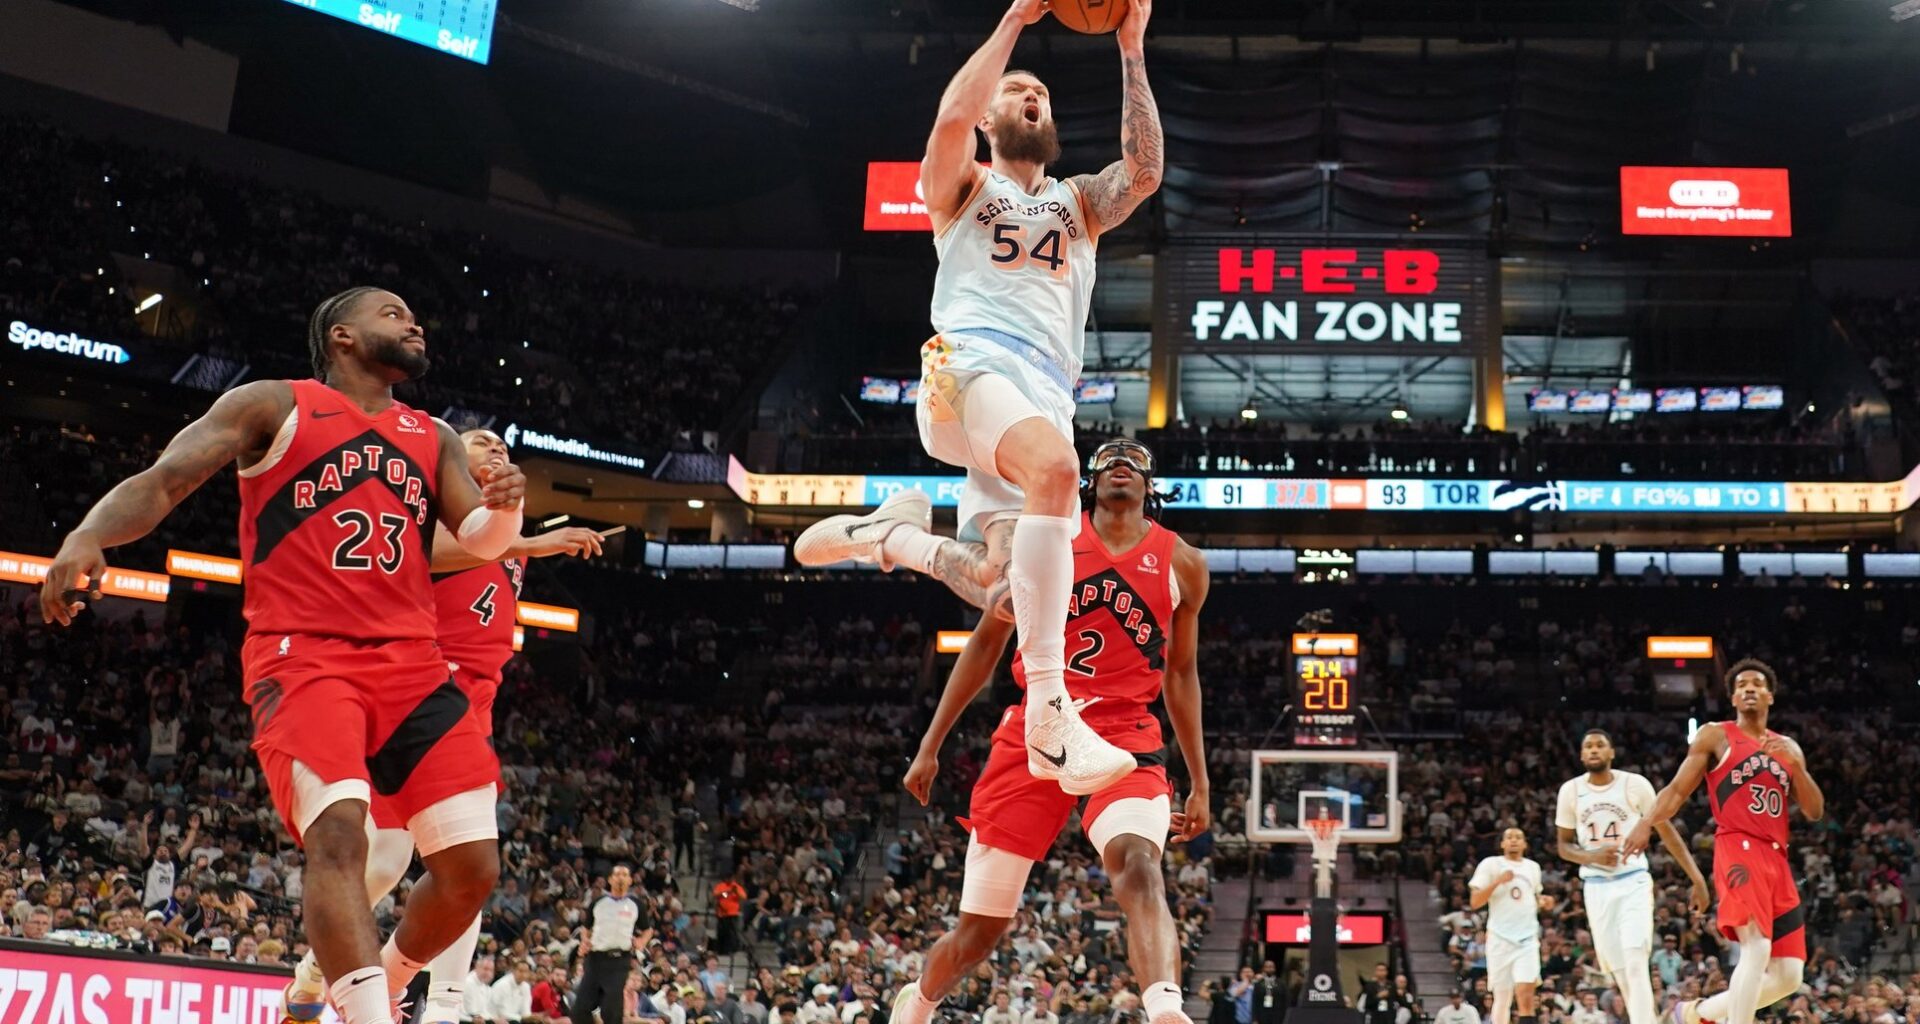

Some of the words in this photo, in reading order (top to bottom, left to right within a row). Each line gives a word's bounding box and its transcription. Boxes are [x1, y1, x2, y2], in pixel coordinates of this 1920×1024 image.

[358, 3, 402, 34] Self
[436, 28, 479, 58] Self
[976, 198, 1014, 226] SAN
[1017, 201, 1077, 239] NTONIO
[991, 223, 1068, 274] 54
[1191, 300, 1298, 341] FAN
[1314, 301, 1462, 342] ZONE
[8, 321, 122, 364] Spectrum
[522, 430, 591, 458] Methodist
[294, 445, 428, 525] RAPTORS
[1223, 484, 1243, 505] 91
[1383, 484, 1406, 505] 93
[1432, 484, 1480, 504] TOR
[1573, 488, 1604, 506] PF
[1633, 488, 1690, 506] FG%
[1728, 488, 1761, 505] TO
[332, 508, 409, 575] 23
[115, 575, 144, 591] EARN
[470, 582, 499, 627] 4
[1069, 579, 1152, 645] APTORS
[1067, 628, 1105, 678] 2
[1301, 661, 1342, 679] 37.4
[1304, 679, 1348, 710] 20
[1312, 715, 1356, 725] TISSOT
[1748, 783, 1783, 818] 30
[1587, 821, 1621, 842] 14
[1511, 886, 1522, 901] 0
[125, 977, 202, 1024] THE
[211, 984, 285, 1024] HUT
